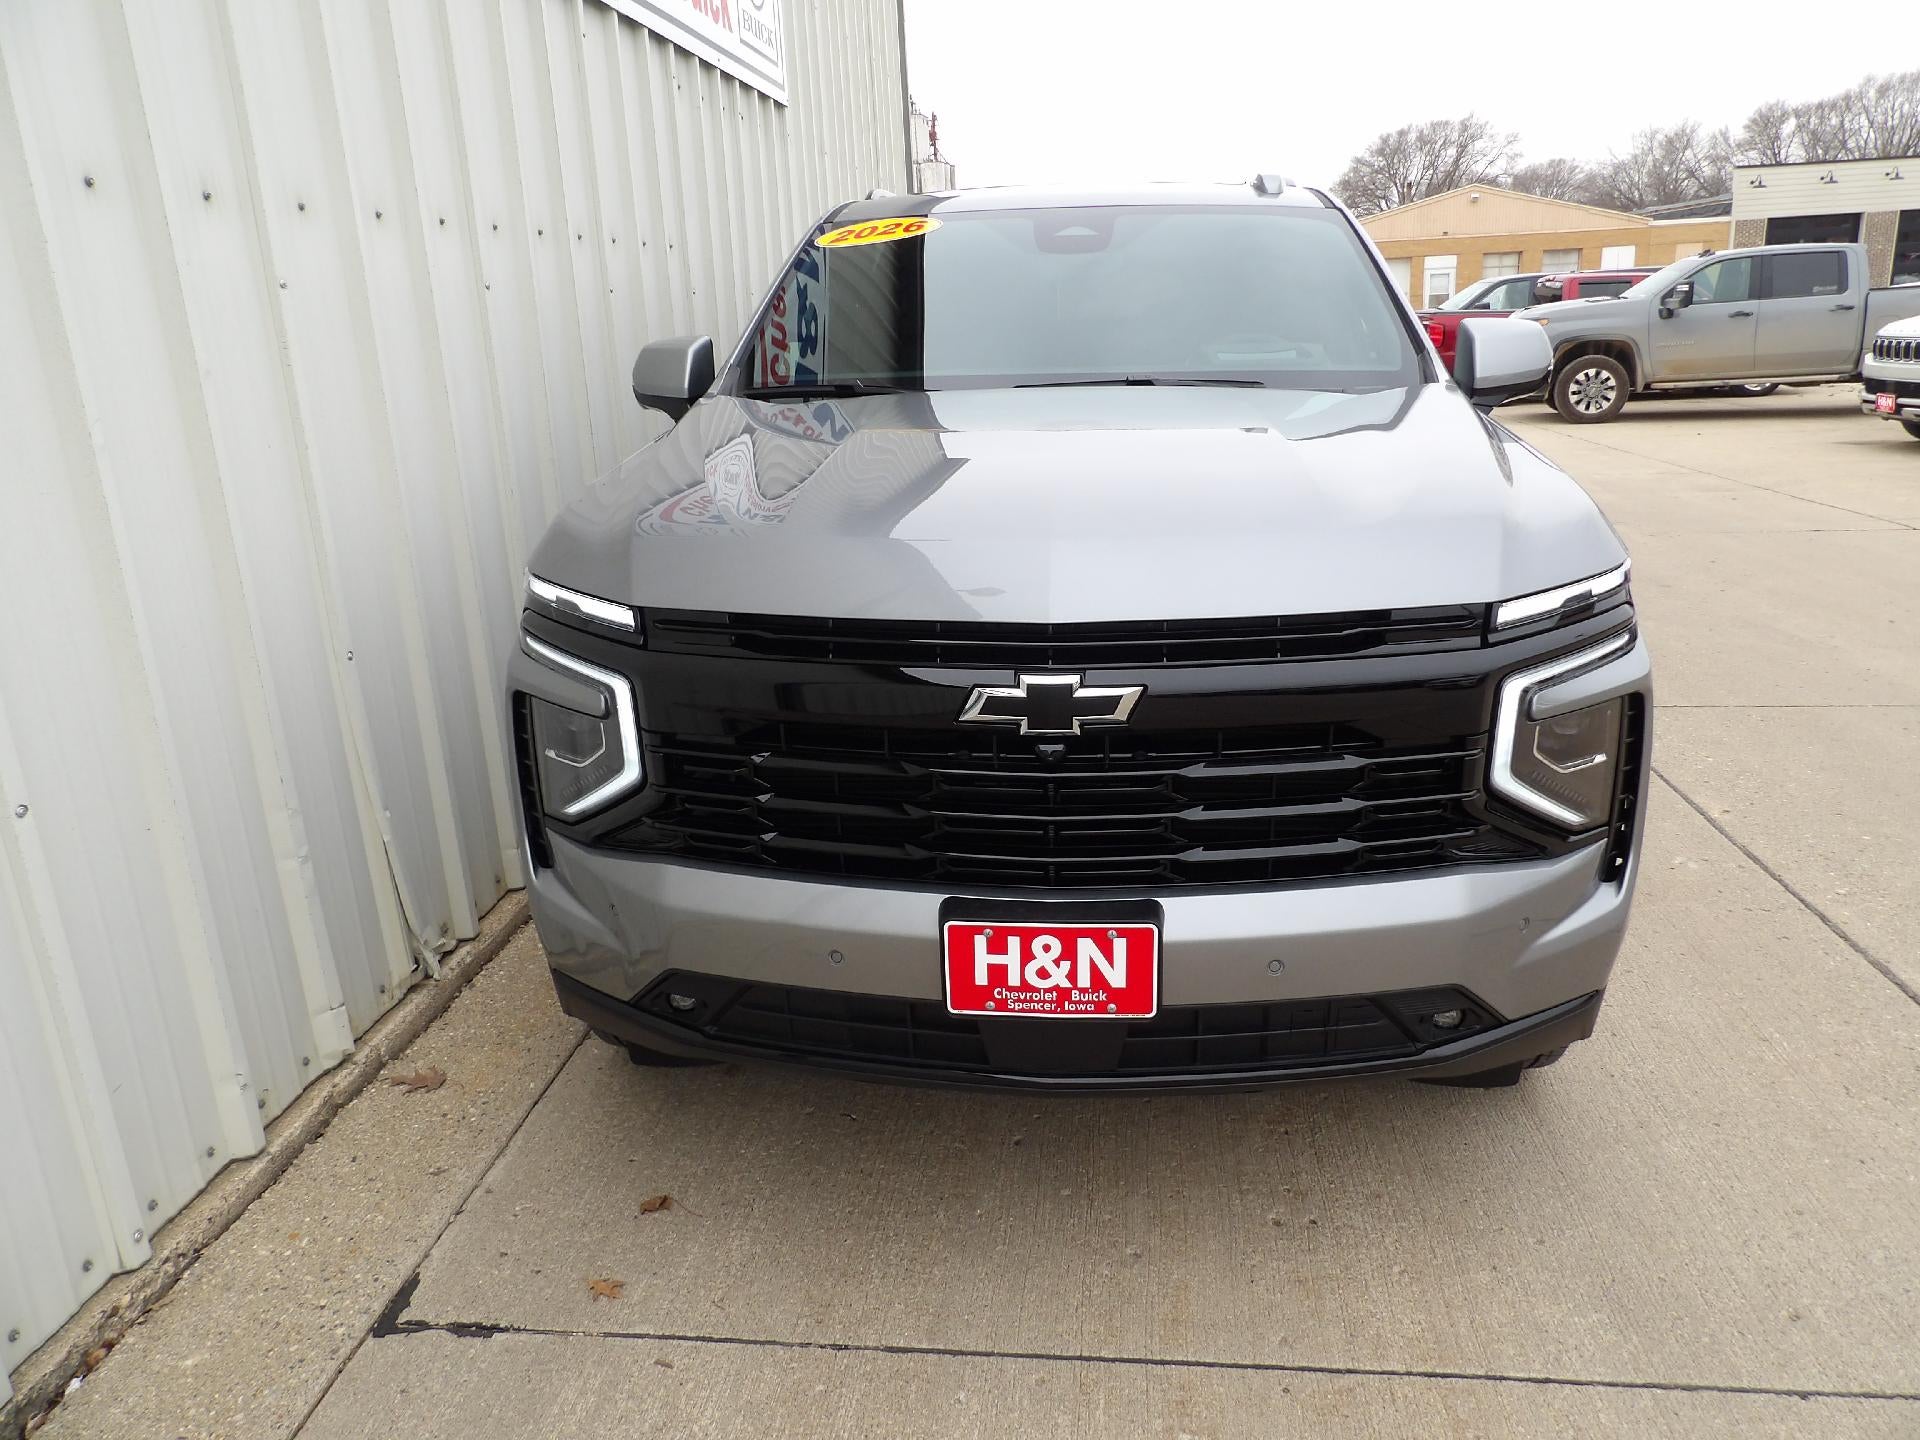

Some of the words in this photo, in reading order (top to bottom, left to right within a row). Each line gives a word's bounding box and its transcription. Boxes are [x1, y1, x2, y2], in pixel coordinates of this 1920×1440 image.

[741, 8, 775, 50] BUICK
[827, 221, 929, 244] 2026
[973, 934, 1128, 989] H&N
[993, 988, 1058, 1001] Chevrolet
[1071, 989, 1108, 1001] Buick
[1007, 999, 1061, 1012] Spencer,
[1064, 1001, 1095, 1011] Iowa
